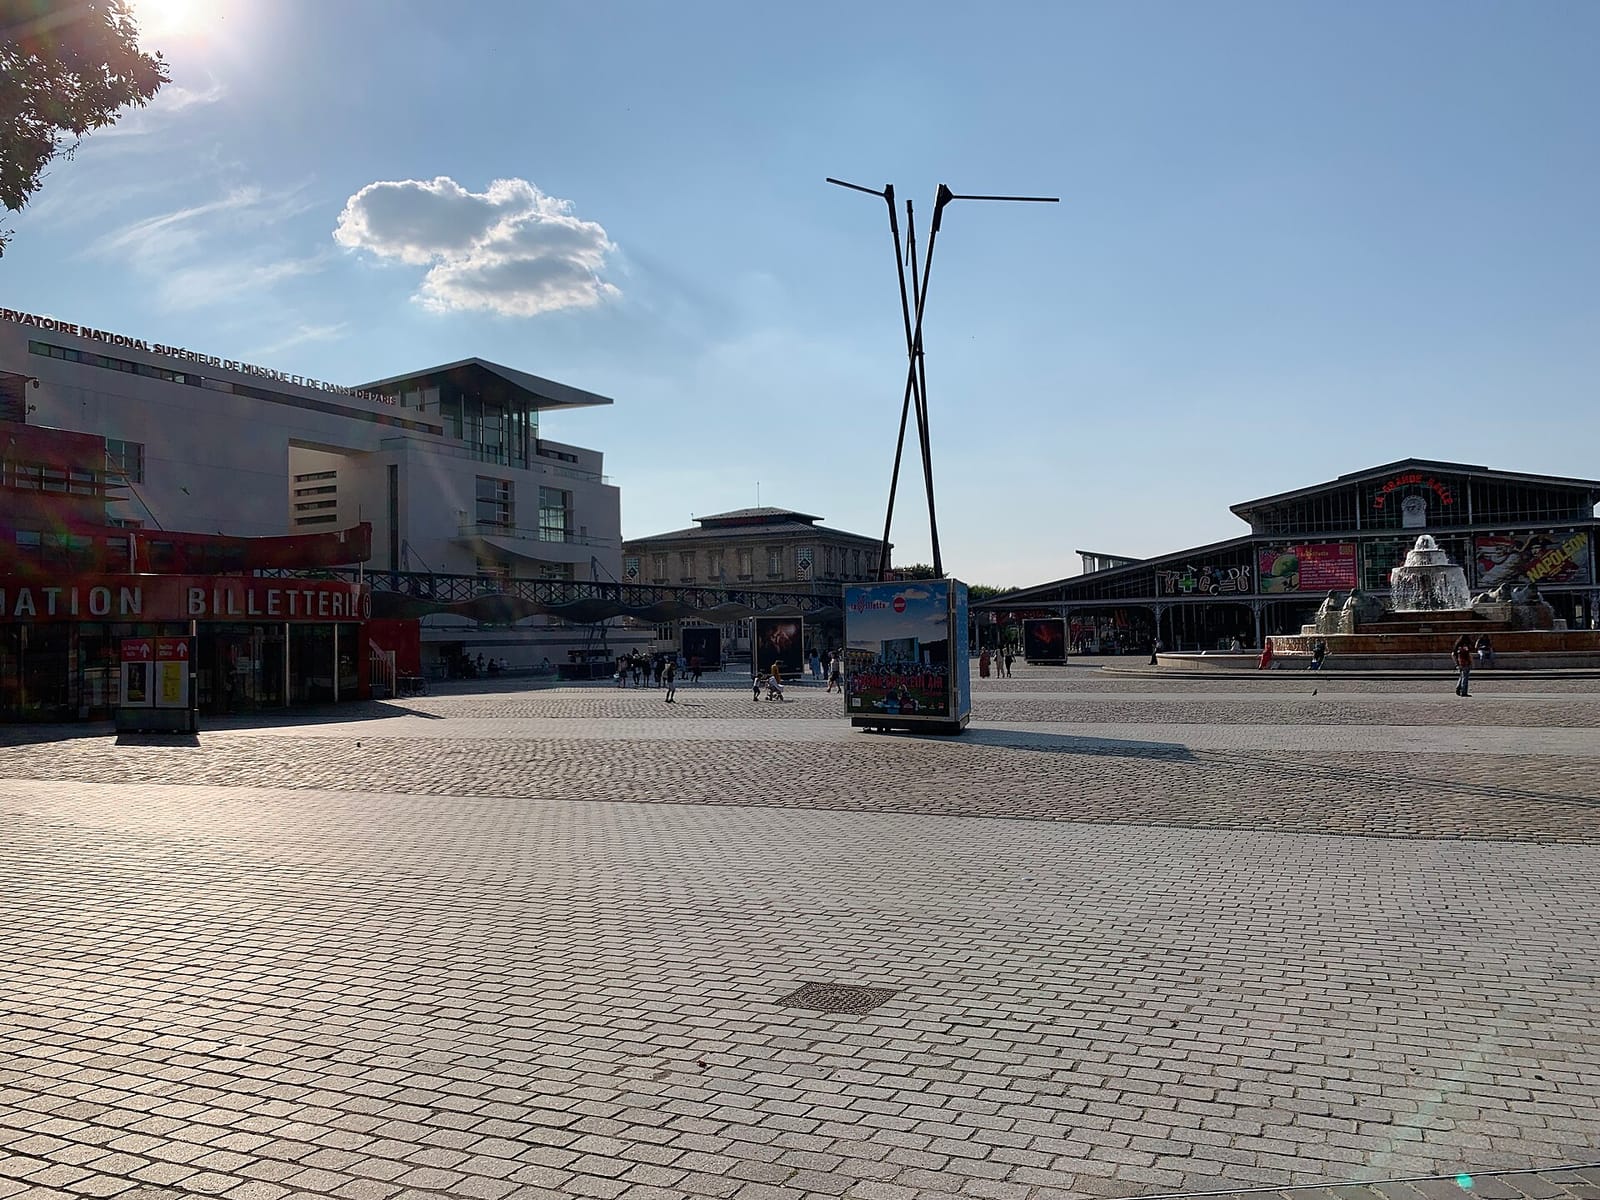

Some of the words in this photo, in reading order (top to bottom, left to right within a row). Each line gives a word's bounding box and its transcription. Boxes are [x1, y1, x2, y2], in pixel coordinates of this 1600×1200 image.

[81, 326, 152, 352] NATIONAL
[153, 342, 223, 369] SUPÉRIEUR
[223, 358, 242, 372] DE
[242, 362, 291, 383] MUSIQUE
[292, 374, 305, 387] ET
[306, 377, 323, 391] DE
[323, 381, 355, 397] DANSE
[356, 389, 370, 399] DE
[370, 391, 397, 406] PARIS
[1381, 472, 1424, 494] GRANDE
[1526, 532, 1587, 583] NAPOLÉON
[0, 586, 143, 617] ATION
[189, 587, 359, 617] BILLETTERIE
